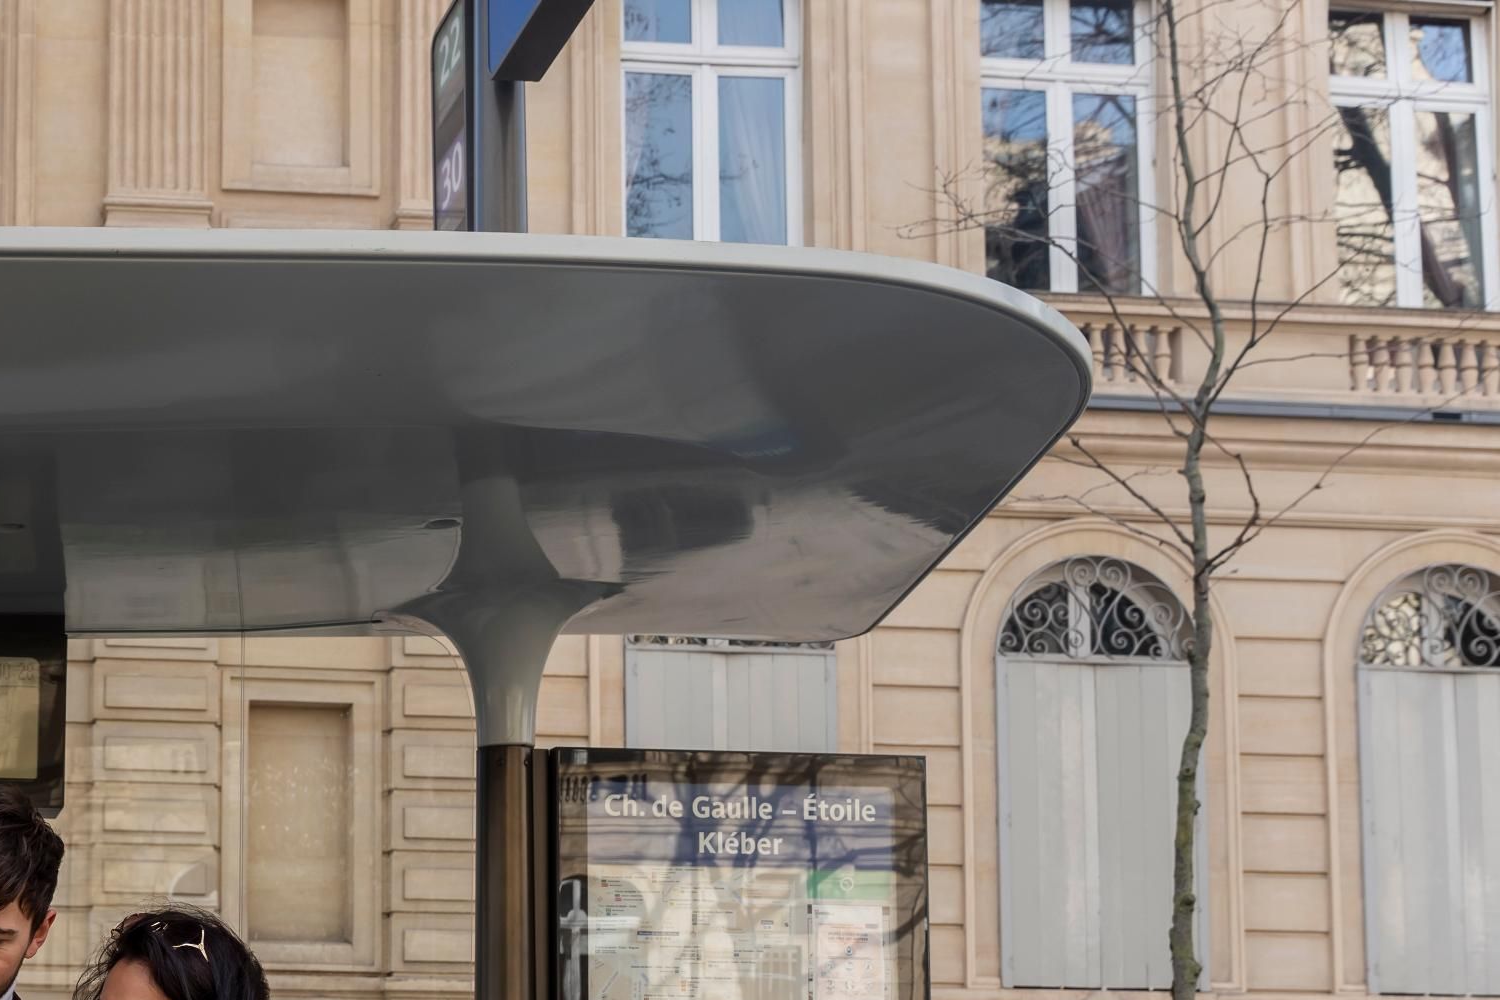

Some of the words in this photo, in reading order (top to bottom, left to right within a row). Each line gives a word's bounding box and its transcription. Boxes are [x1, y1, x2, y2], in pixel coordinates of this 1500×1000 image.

[440, 16, 461, 88] 22
[441, 141, 462, 211] 30
[604, 793, 645, 818] Ch.
[652, 795, 684, 818] de
[691, 796, 774, 820] Gaulle
[803, 793, 877, 822] Étoile
[698, 831, 784, 856] Kléber
